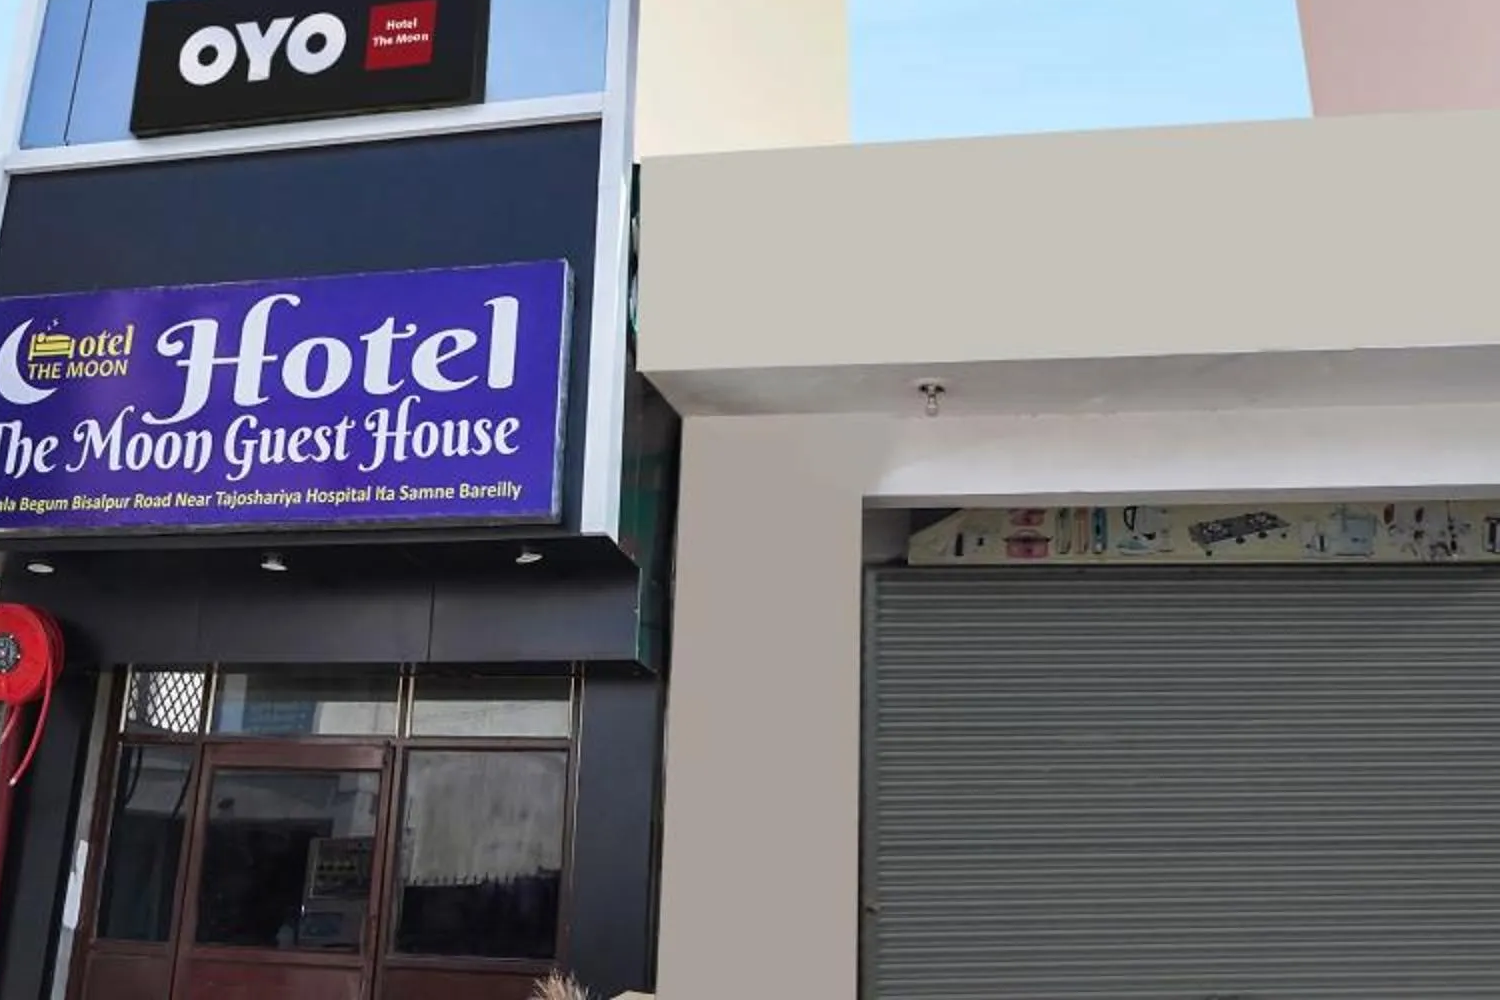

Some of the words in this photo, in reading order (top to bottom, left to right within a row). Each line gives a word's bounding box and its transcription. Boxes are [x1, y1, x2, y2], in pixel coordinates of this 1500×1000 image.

[386, 16, 418, 30] Hotel
[179, 12, 347, 86] OYO
[372, 35, 393, 47] The
[395, 33, 429, 44] Moon
[28, 362, 62, 380] THE
[65, 360, 129, 379] MOON
[141, 293, 519, 425] Hotel
[65, 405, 213, 474] Moon
[223, 415, 357, 482] Guest
[358, 395, 520, 472] House
[19, 496, 68, 514] Begum
[71, 493, 131, 513] Bisalpur
[134, 492, 173, 509] Road
[175, 492, 212, 508] Near
[215, 488, 301, 509] Tajoshariya
[305, 485, 371, 506] Hospital
[399, 484, 455, 501] Samne
[459, 481, 523, 501] Bareilly
